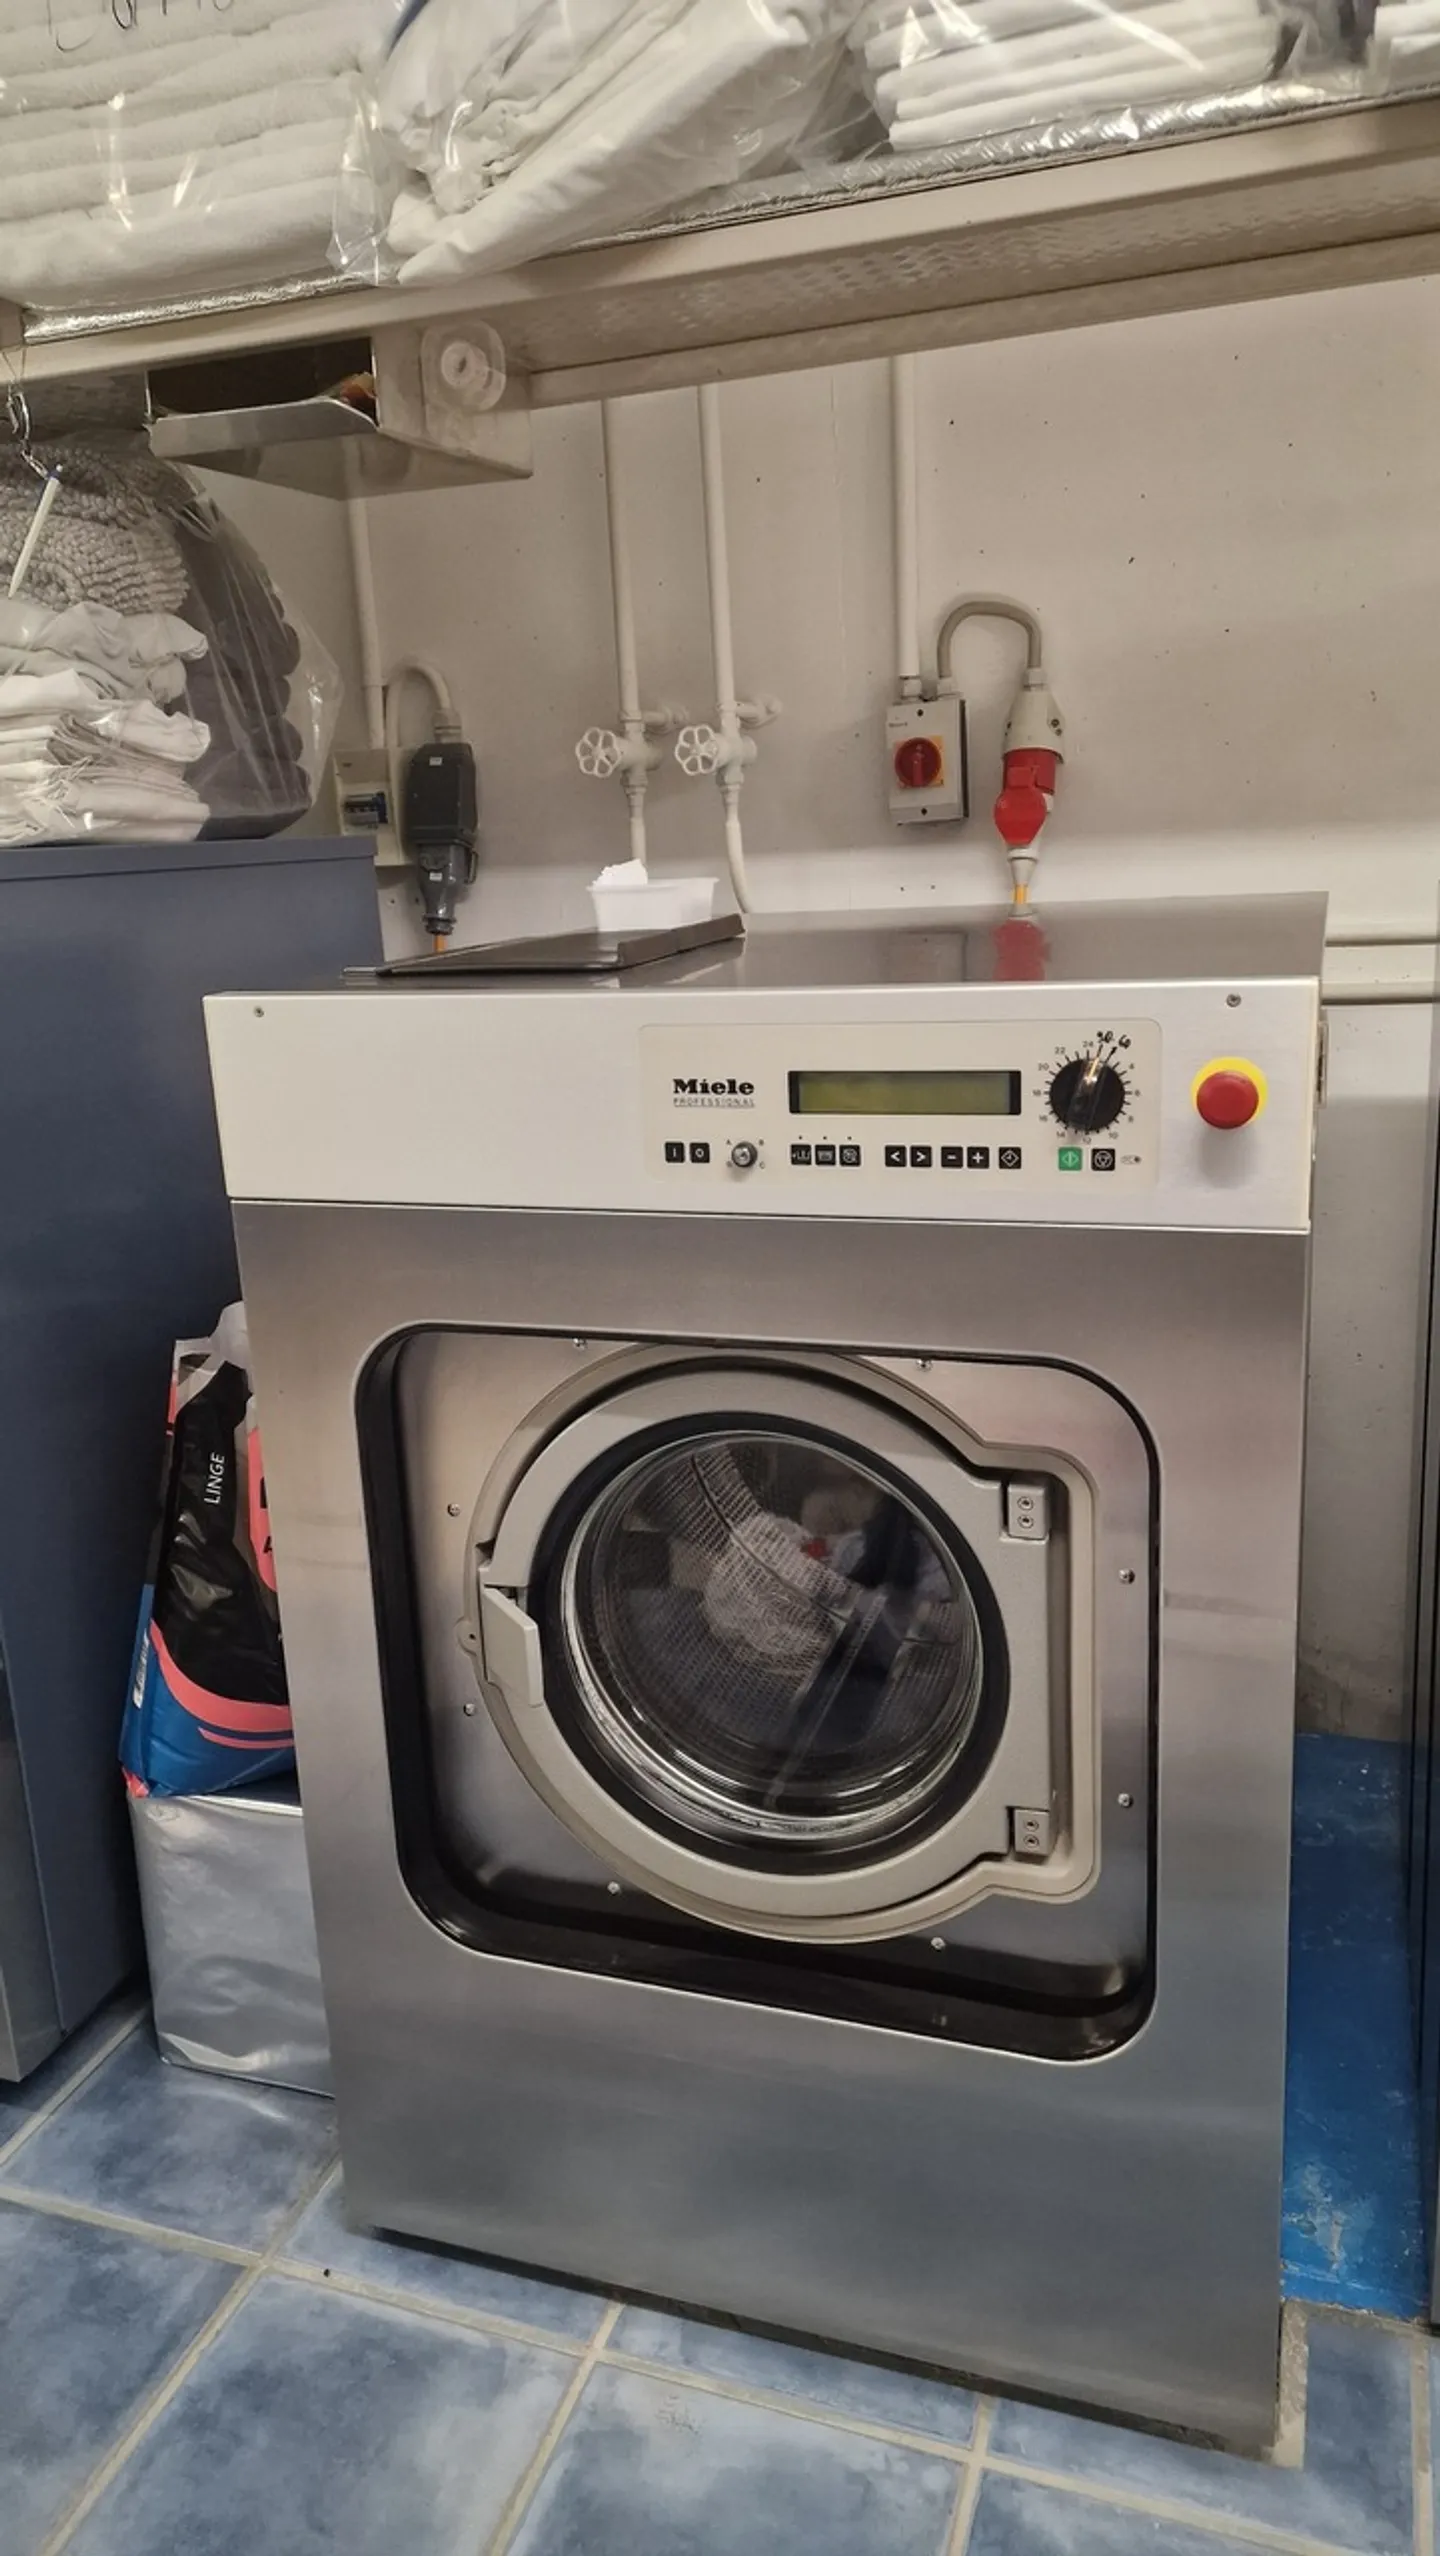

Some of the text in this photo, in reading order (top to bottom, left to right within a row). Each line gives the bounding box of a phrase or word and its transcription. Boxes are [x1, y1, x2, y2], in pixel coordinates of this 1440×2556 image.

[673, 1078, 754, 1096] Miele
[673, 1097, 755, 1108] PROFESSIONAL
[203, 1452, 225, 1505] LINGE
